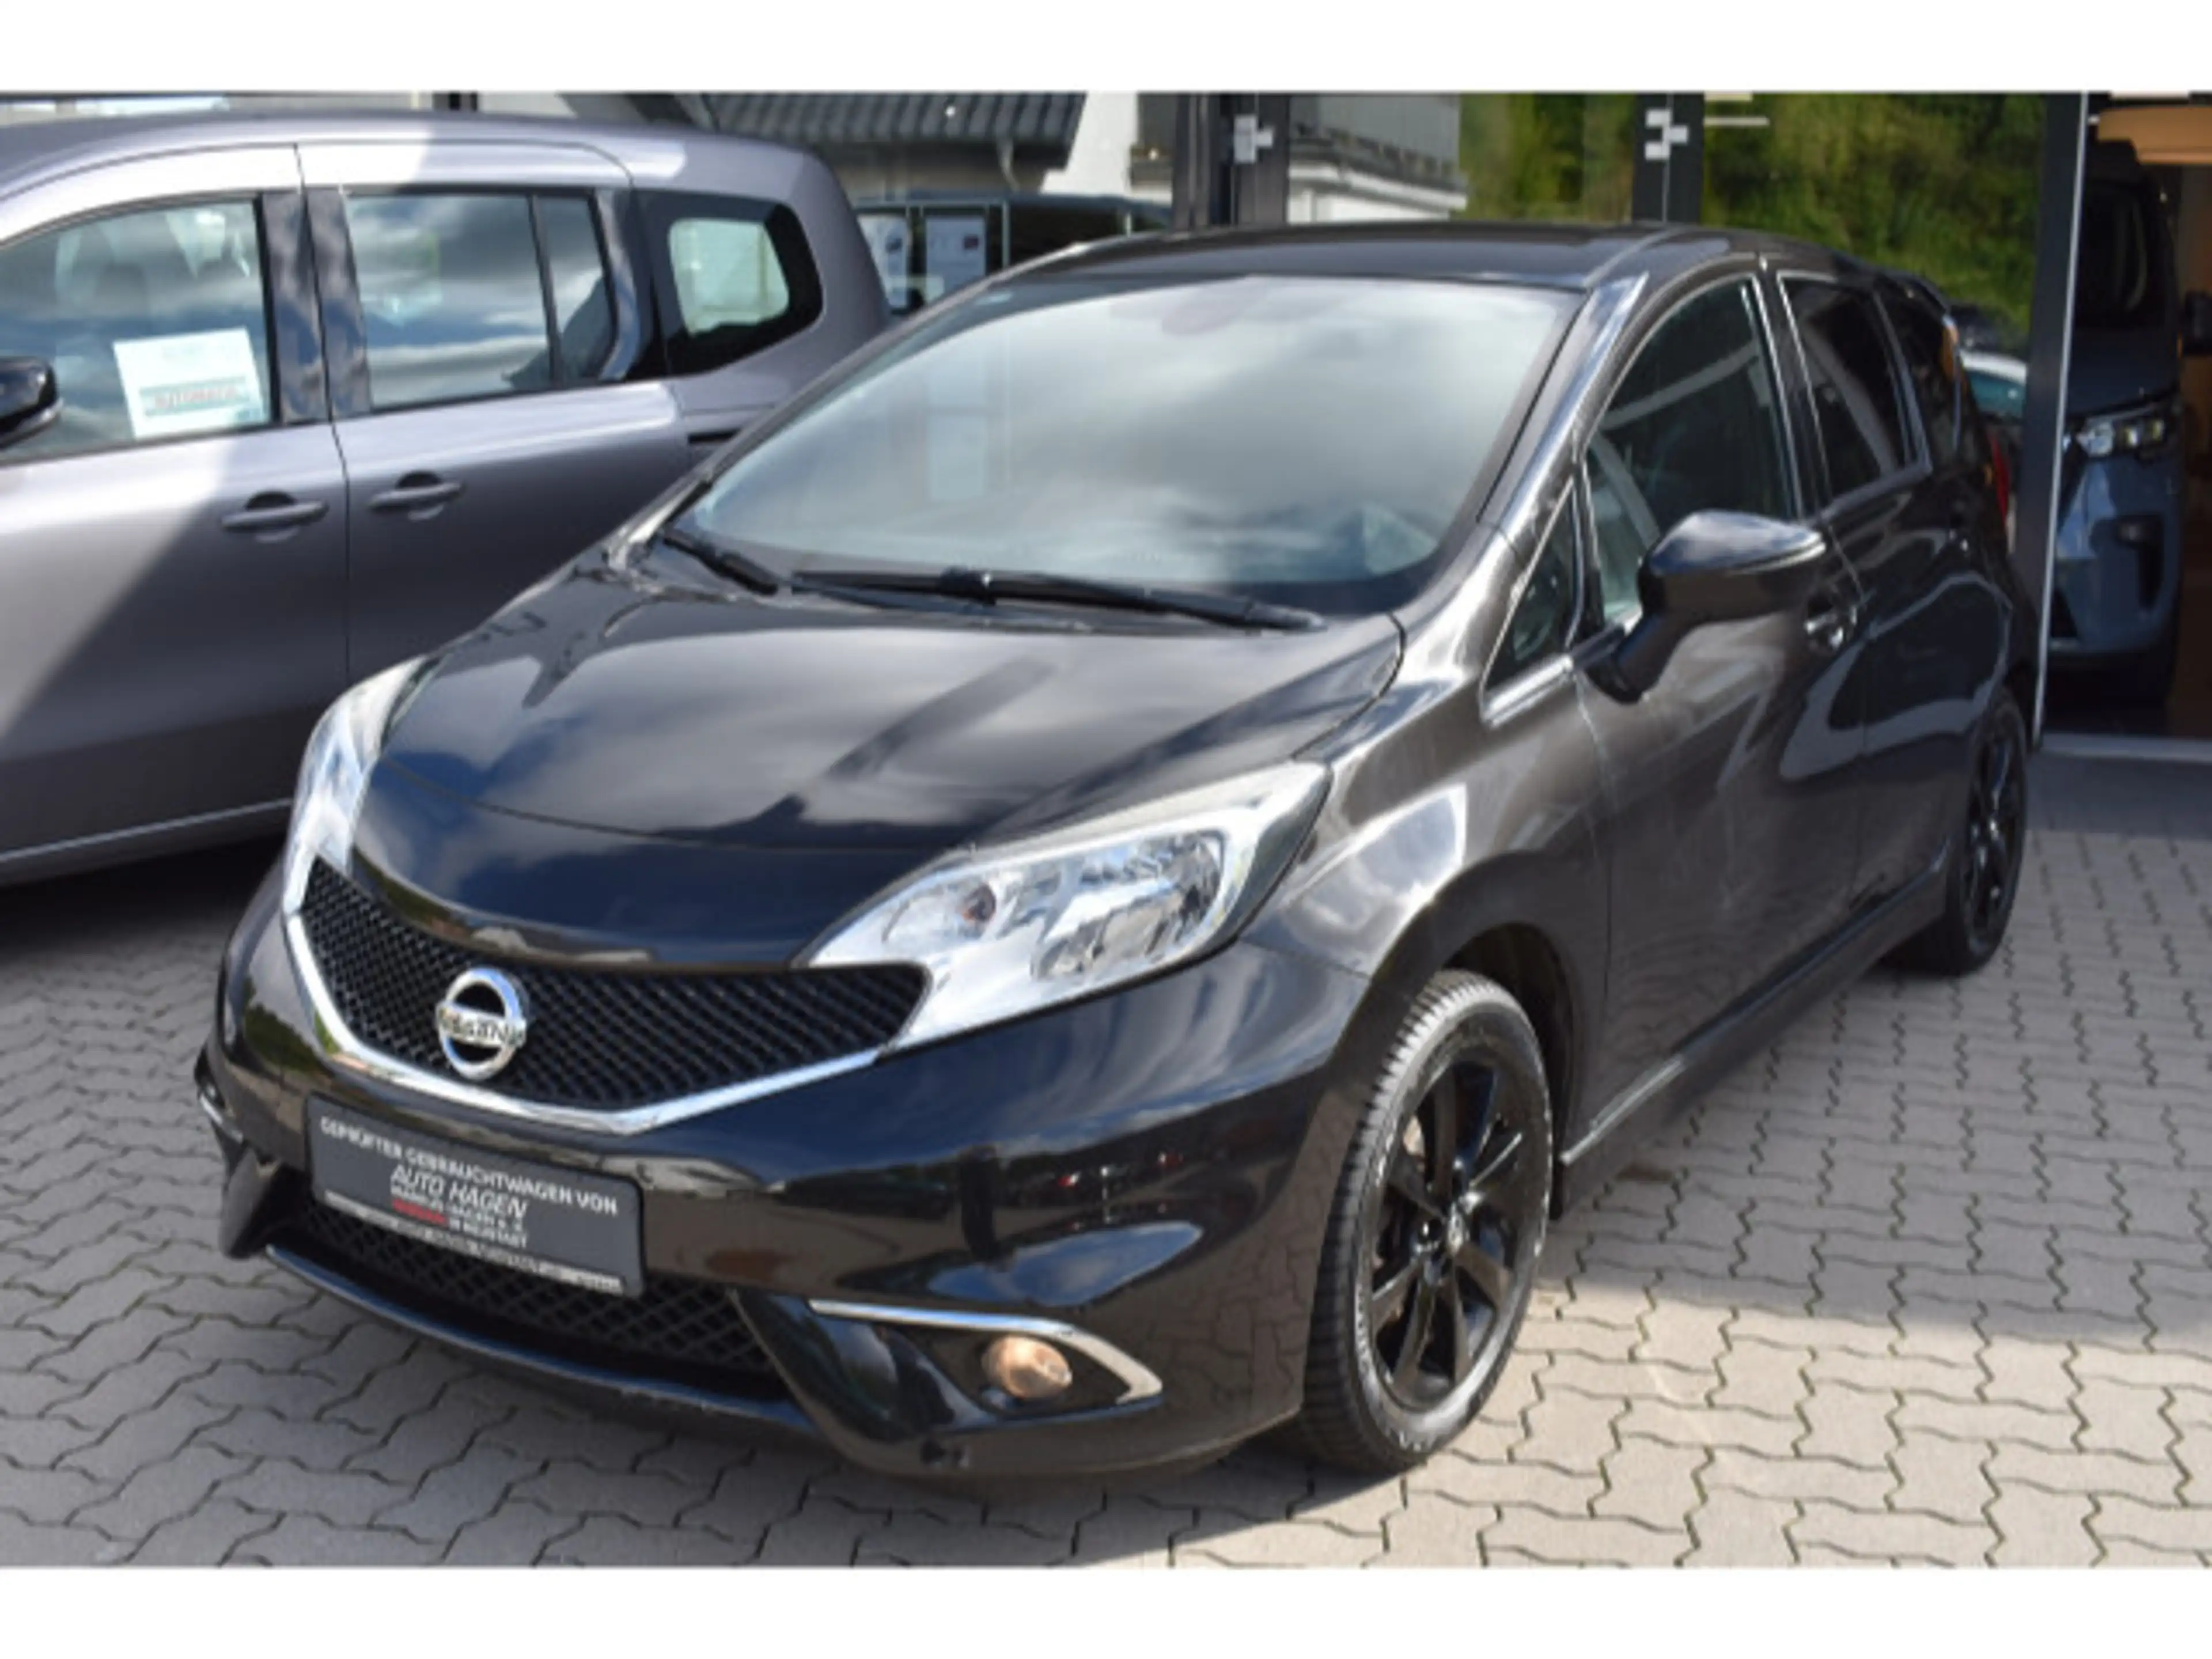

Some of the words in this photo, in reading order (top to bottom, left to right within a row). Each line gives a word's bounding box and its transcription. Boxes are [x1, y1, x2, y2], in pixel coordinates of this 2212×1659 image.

[391, 1163, 445, 1196] AUTO
[449, 1181, 528, 1218] HAGEN
[404, 1146, 573, 1205] GEBRAUCHTWAGEN
[576, 1189, 618, 1217] VON
